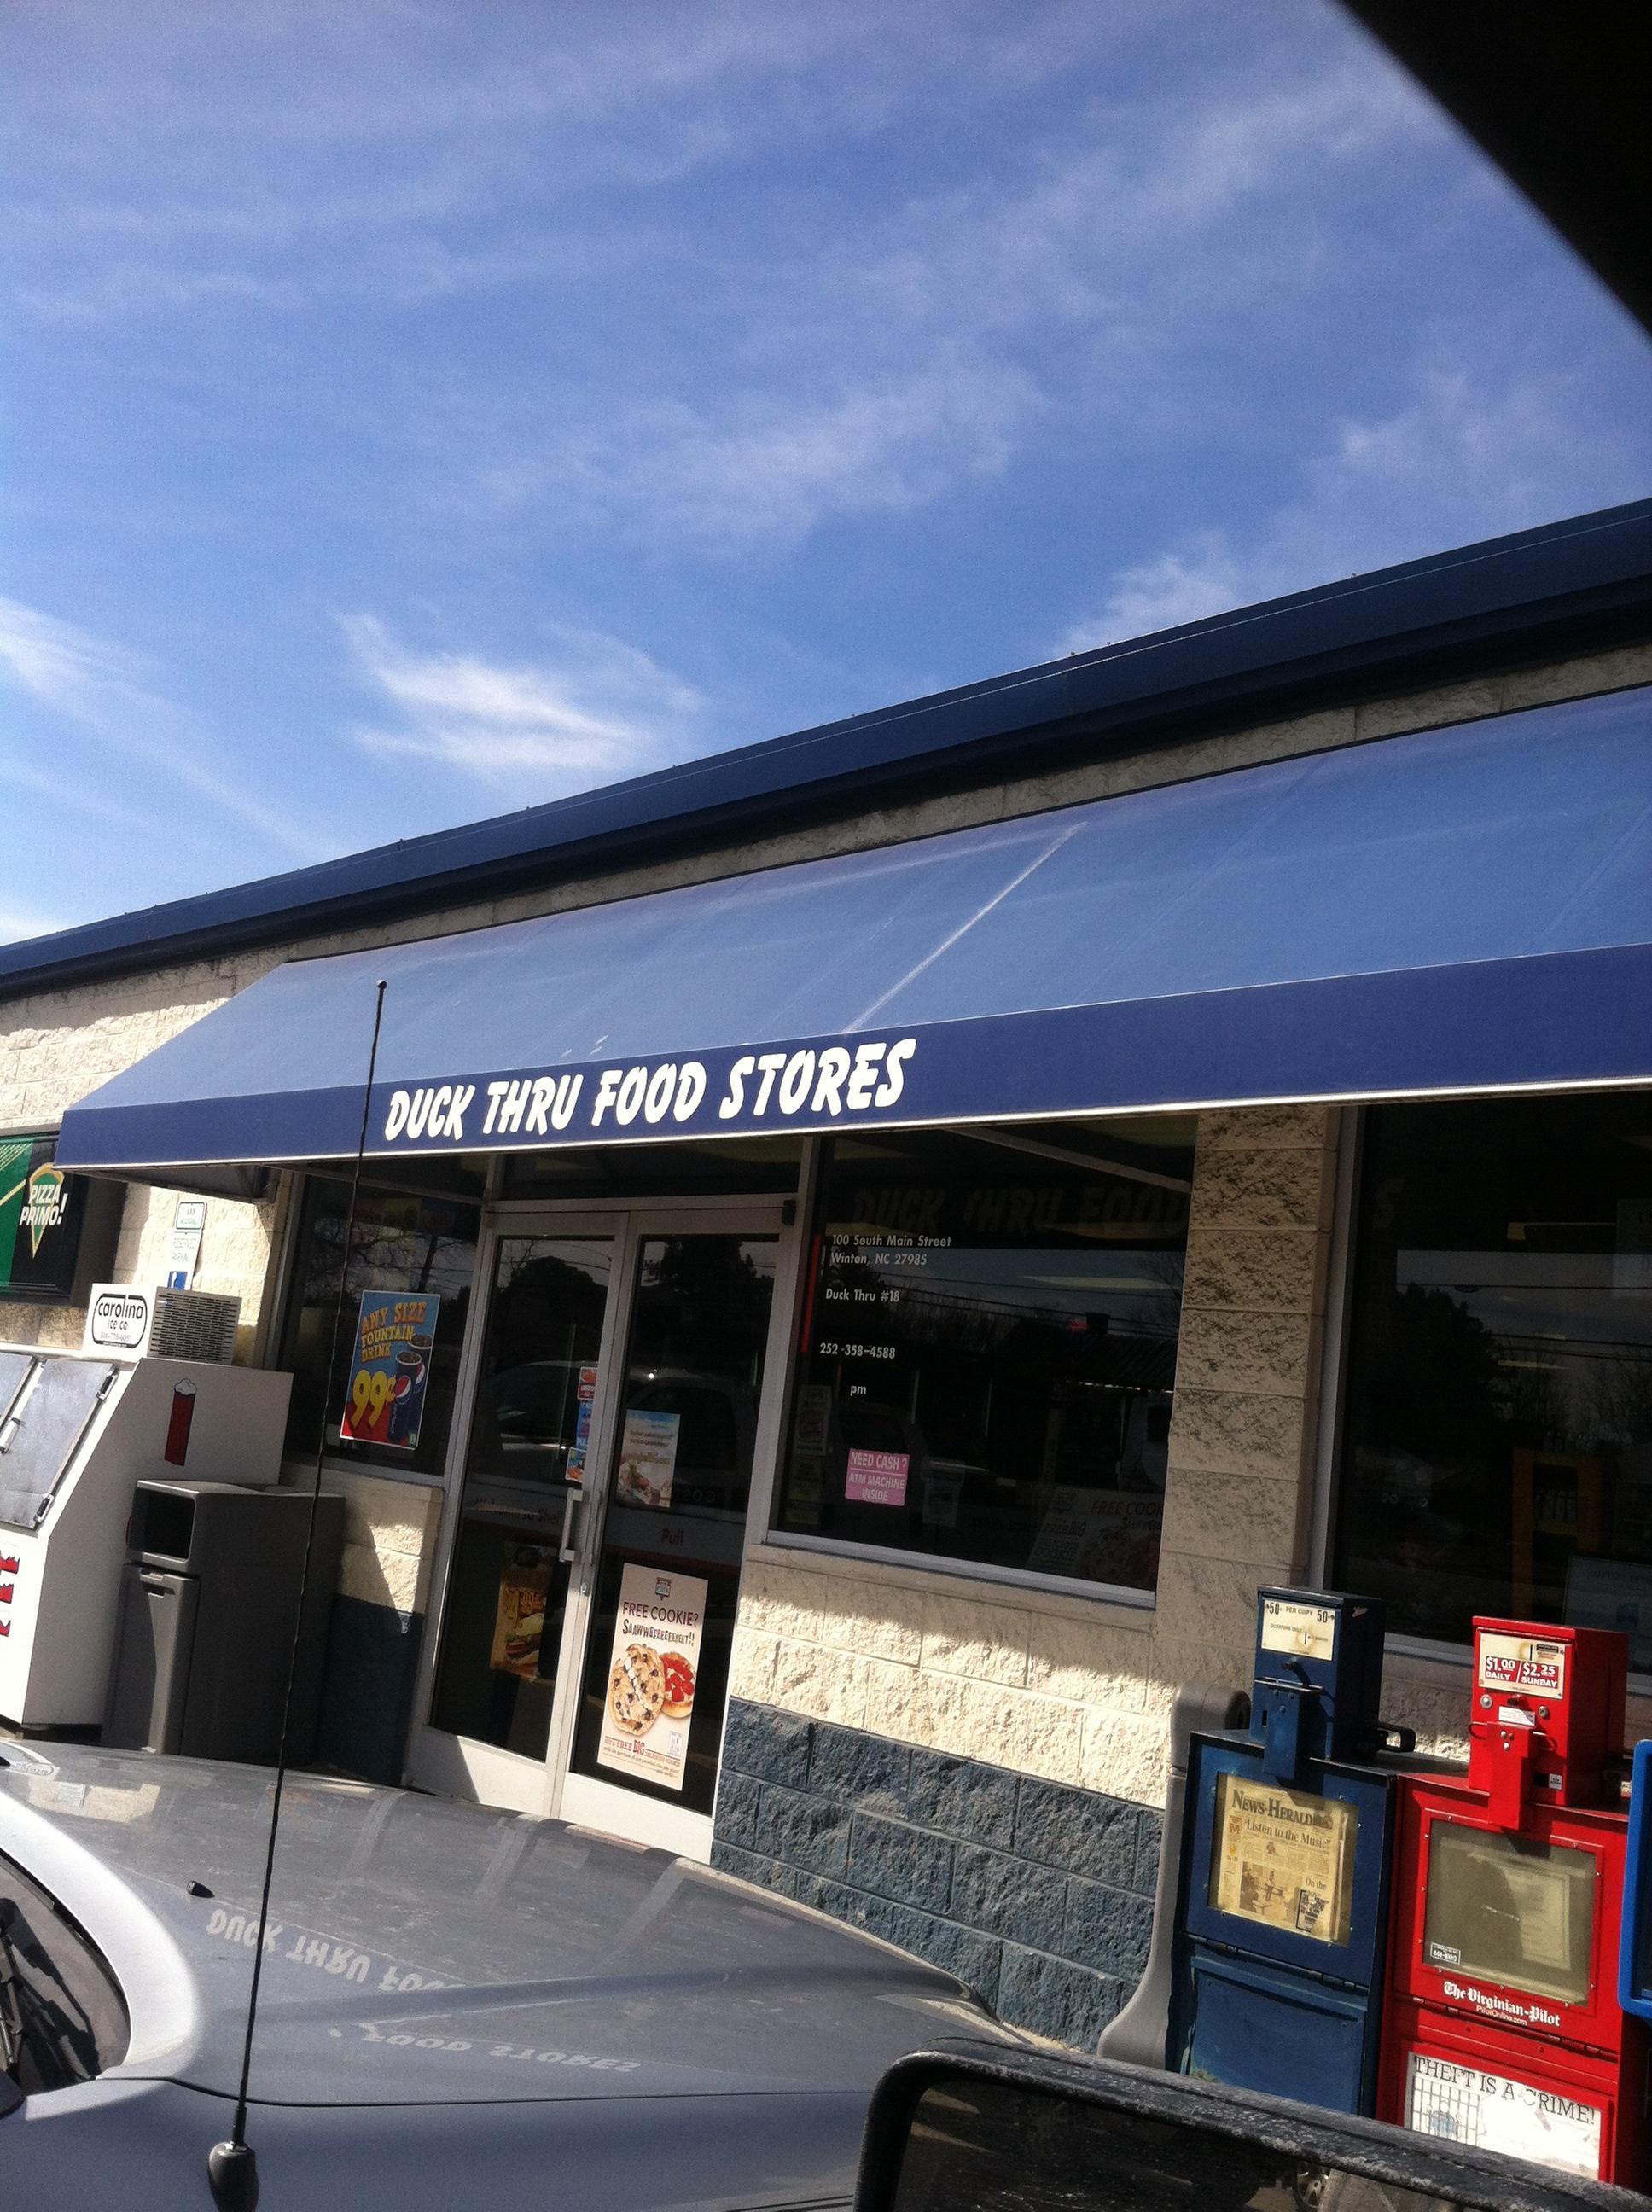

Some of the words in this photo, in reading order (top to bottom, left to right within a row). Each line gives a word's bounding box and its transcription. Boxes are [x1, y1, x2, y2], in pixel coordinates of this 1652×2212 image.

[384, 1084, 476, 1141] DUCK
[482, 1074, 584, 1136] THRU
[591, 1061, 707, 1126] FOOD
[719, 1038, 917, 1119] STORES
[28, 1184, 61, 1204] PIZZA
[19, 1193, 68, 1225] PRIMO!
[833, 1234, 849, 1245] 100
[853, 1234, 882, 1247] South
[887, 1234, 913, 1247] Main
[918, 1235, 952, 1248] Street
[830, 1252, 870, 1266] Winton,
[875, 1253, 890, 1264] NC
[895, 1253, 928, 1266] 27985
[825, 1288, 850, 1301] Duck
[854, 1289, 875, 1301] Thru
[880, 1290, 900, 1302] #18
[98, 1296, 143, 1319] carolina
[361, 1307, 389, 1334] ANY
[393, 1301, 427, 1324] SIZE
[361, 1325, 416, 1348] FOUNTAIN
[361, 1342, 392, 1363] DRINK
[850, 1385, 867, 1396] pm
[850, 1452, 874, 1467] NEED
[876, 1454, 900, 1470] CASH
[848, 1473, 866, 1484] ATM
[867, 1475, 905, 1489] MACHINE
[861, 1488, 888, 1500] INSIDE
[622, 1601, 649, 1619] FREE
[650, 1606, 700, 1627] COOKIE?
[1286, 1605, 1297, 1614] PER
[1486, 1656, 1516, 1671] $1.00
[1522, 1662, 1556, 1678] $2.25
[1486, 1671, 1511, 1681] DAILY
[1521, 1676, 1558, 1688] SUNDAY
[1274, 1826, 1283, 1838] to
[1284, 1829, 1300, 1842] the
[1444, 1981, 1466, 2000] The
[1466, 1988, 1561, 2027] Virginian-Pilot
[1475, 2005, 1527, 2026] PilotOnline.com
[1413, 2055, 1476, 2088] THEFT
[1480, 2075, 1497, 2094] IS
[1501, 2082, 1515, 2100] A
